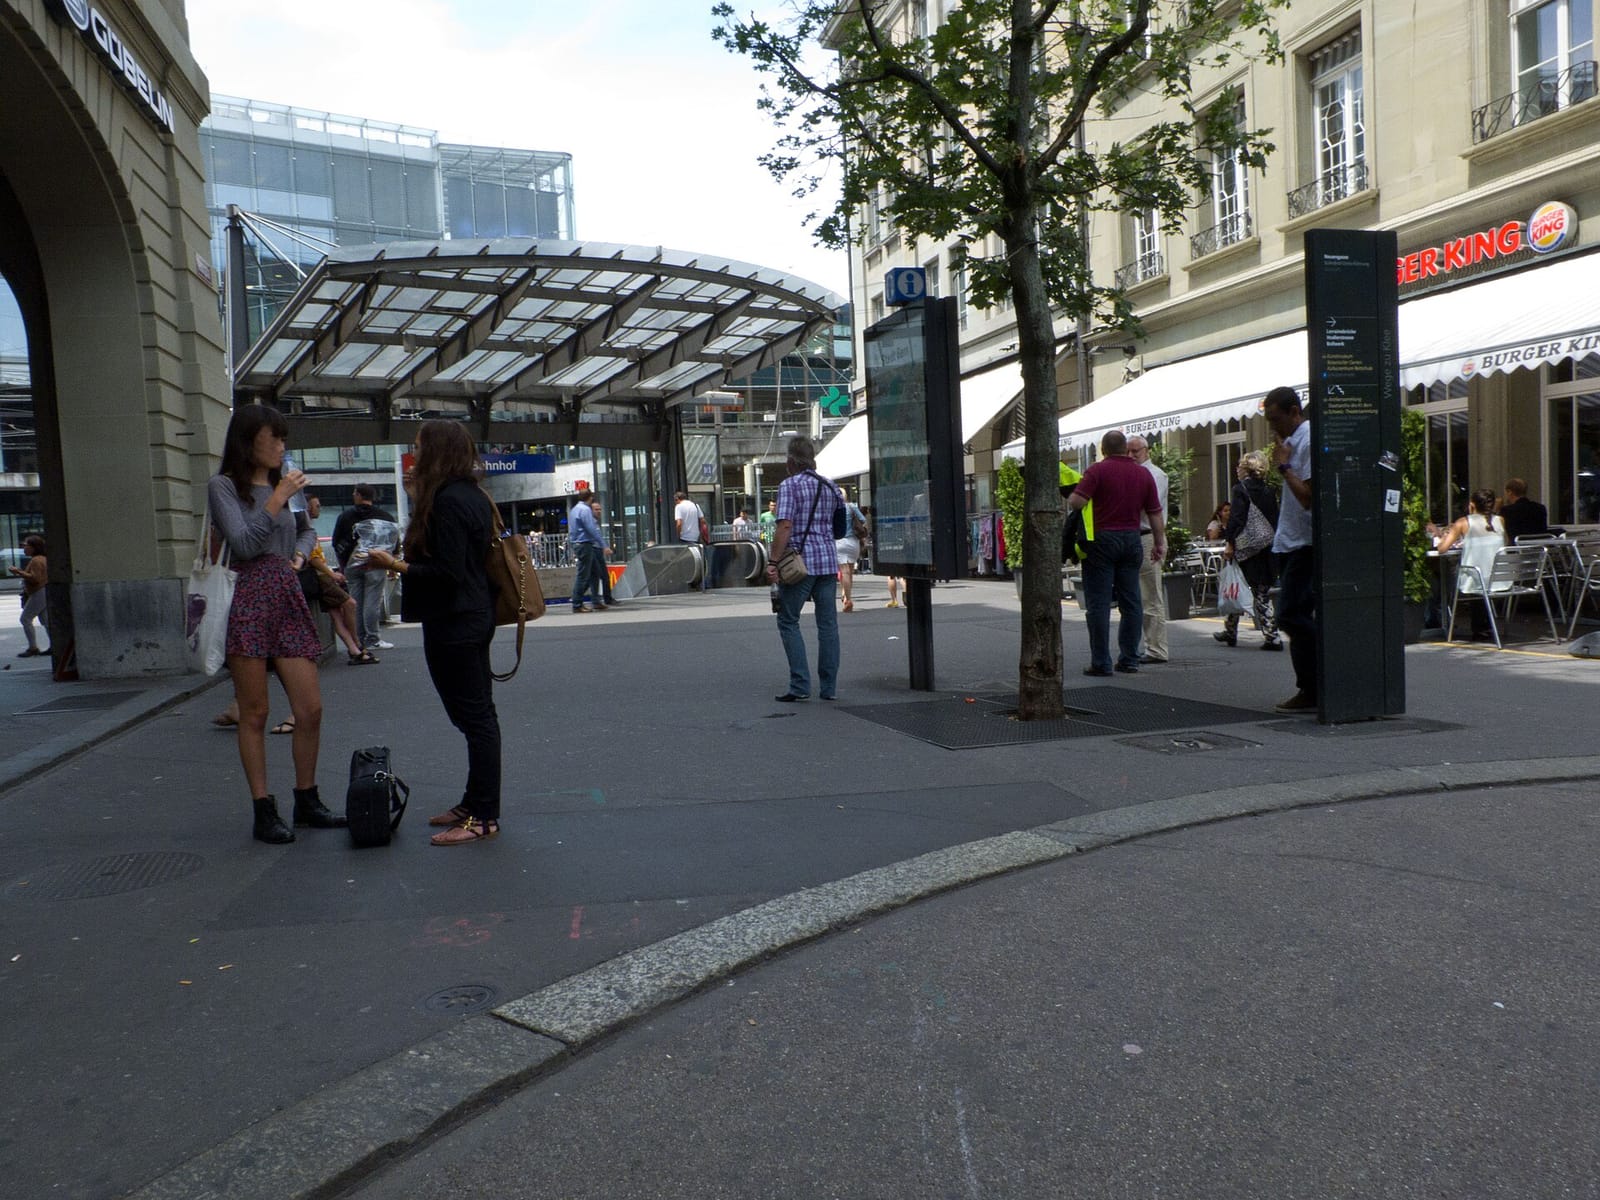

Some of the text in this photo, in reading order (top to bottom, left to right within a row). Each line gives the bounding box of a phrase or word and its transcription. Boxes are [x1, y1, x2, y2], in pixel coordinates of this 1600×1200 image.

[91, 7, 175, 134] GOBELIN
[1532, 208, 1565, 228] BURGER
[1532, 217, 1565, 244] KING
[1443, 220, 1521, 274] KING
[1384, 354, 1392, 368] zu
[1481, 342, 1562, 370] BURGER
[1383, 368, 1394, 400] Wege
[1126, 416, 1182, 435] BURGER KING
